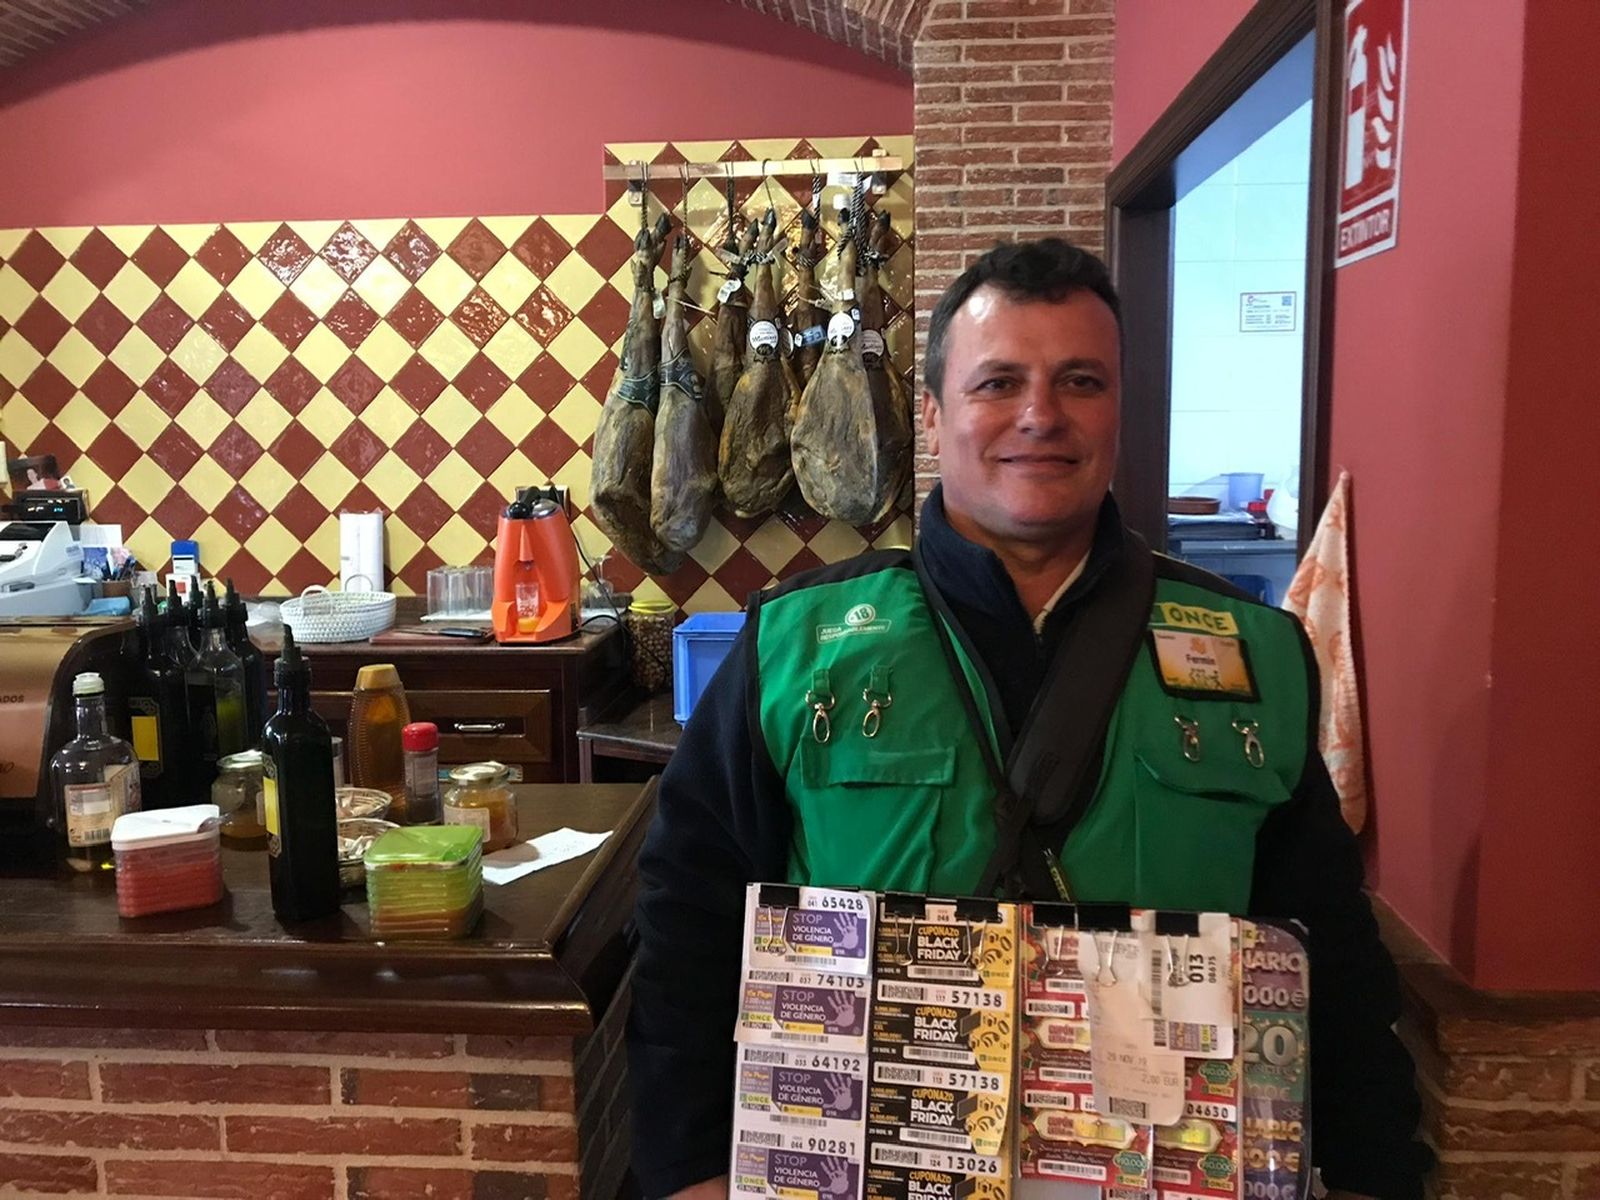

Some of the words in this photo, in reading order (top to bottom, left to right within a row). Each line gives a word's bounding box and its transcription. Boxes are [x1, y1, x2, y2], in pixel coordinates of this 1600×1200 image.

[1341, 209, 1390, 251] EXTINTOR
[1169, 607, 1229, 630] ONCE
[822, 896, 864, 910] 65428
[793, 913, 822, 924] STOP
[792, 925, 832, 935] VIOLENCIA
[918, 926, 960, 936] CUPONAZO
[804, 934, 834, 944] GÉNERO
[917, 936, 959, 949] BLACK
[917, 948, 961, 961] FRIDAY
[1189, 953, 1205, 983] 013
[817, 974, 864, 988] 74103
[782, 990, 815, 1002] STOP
[952, 991, 1002, 1008] 57138
[782, 1003, 824, 1013] VIOLENCIA
[915, 1007, 957, 1017] CUPONAZO
[793, 1011, 826, 1021] GÉNERO
[914, 1016, 956, 1030] BLACK
[913, 1028, 958, 1042] FRIDAY
[811, 1055, 860, 1072] 64192
[779, 1071, 811, 1083] STOP
[949, 1073, 999, 1091] 57138
[778, 1084, 821, 1095] VIOLENCIA
[912, 1089, 954, 1101] CUPONAZO
[790, 1093, 824, 1103] GÉNERO
[911, 1099, 953, 1113] BLACK
[1186, 1103, 1229, 1119] 04630
[910, 1111, 955, 1126] FRIDAY
[808, 1138, 855, 1155] 90281
[774, 1154, 807, 1165] STOP
[947, 1156, 997, 1173] 13026
[774, 1167, 818, 1178] VIOLENCIA
[909, 1171, 952, 1183] CUPONAZO
[774, 1175, 785, 1183] DE
[786, 1176, 820, 1187] GÉNERO
[908, 1181, 950, 1196] BLACK
